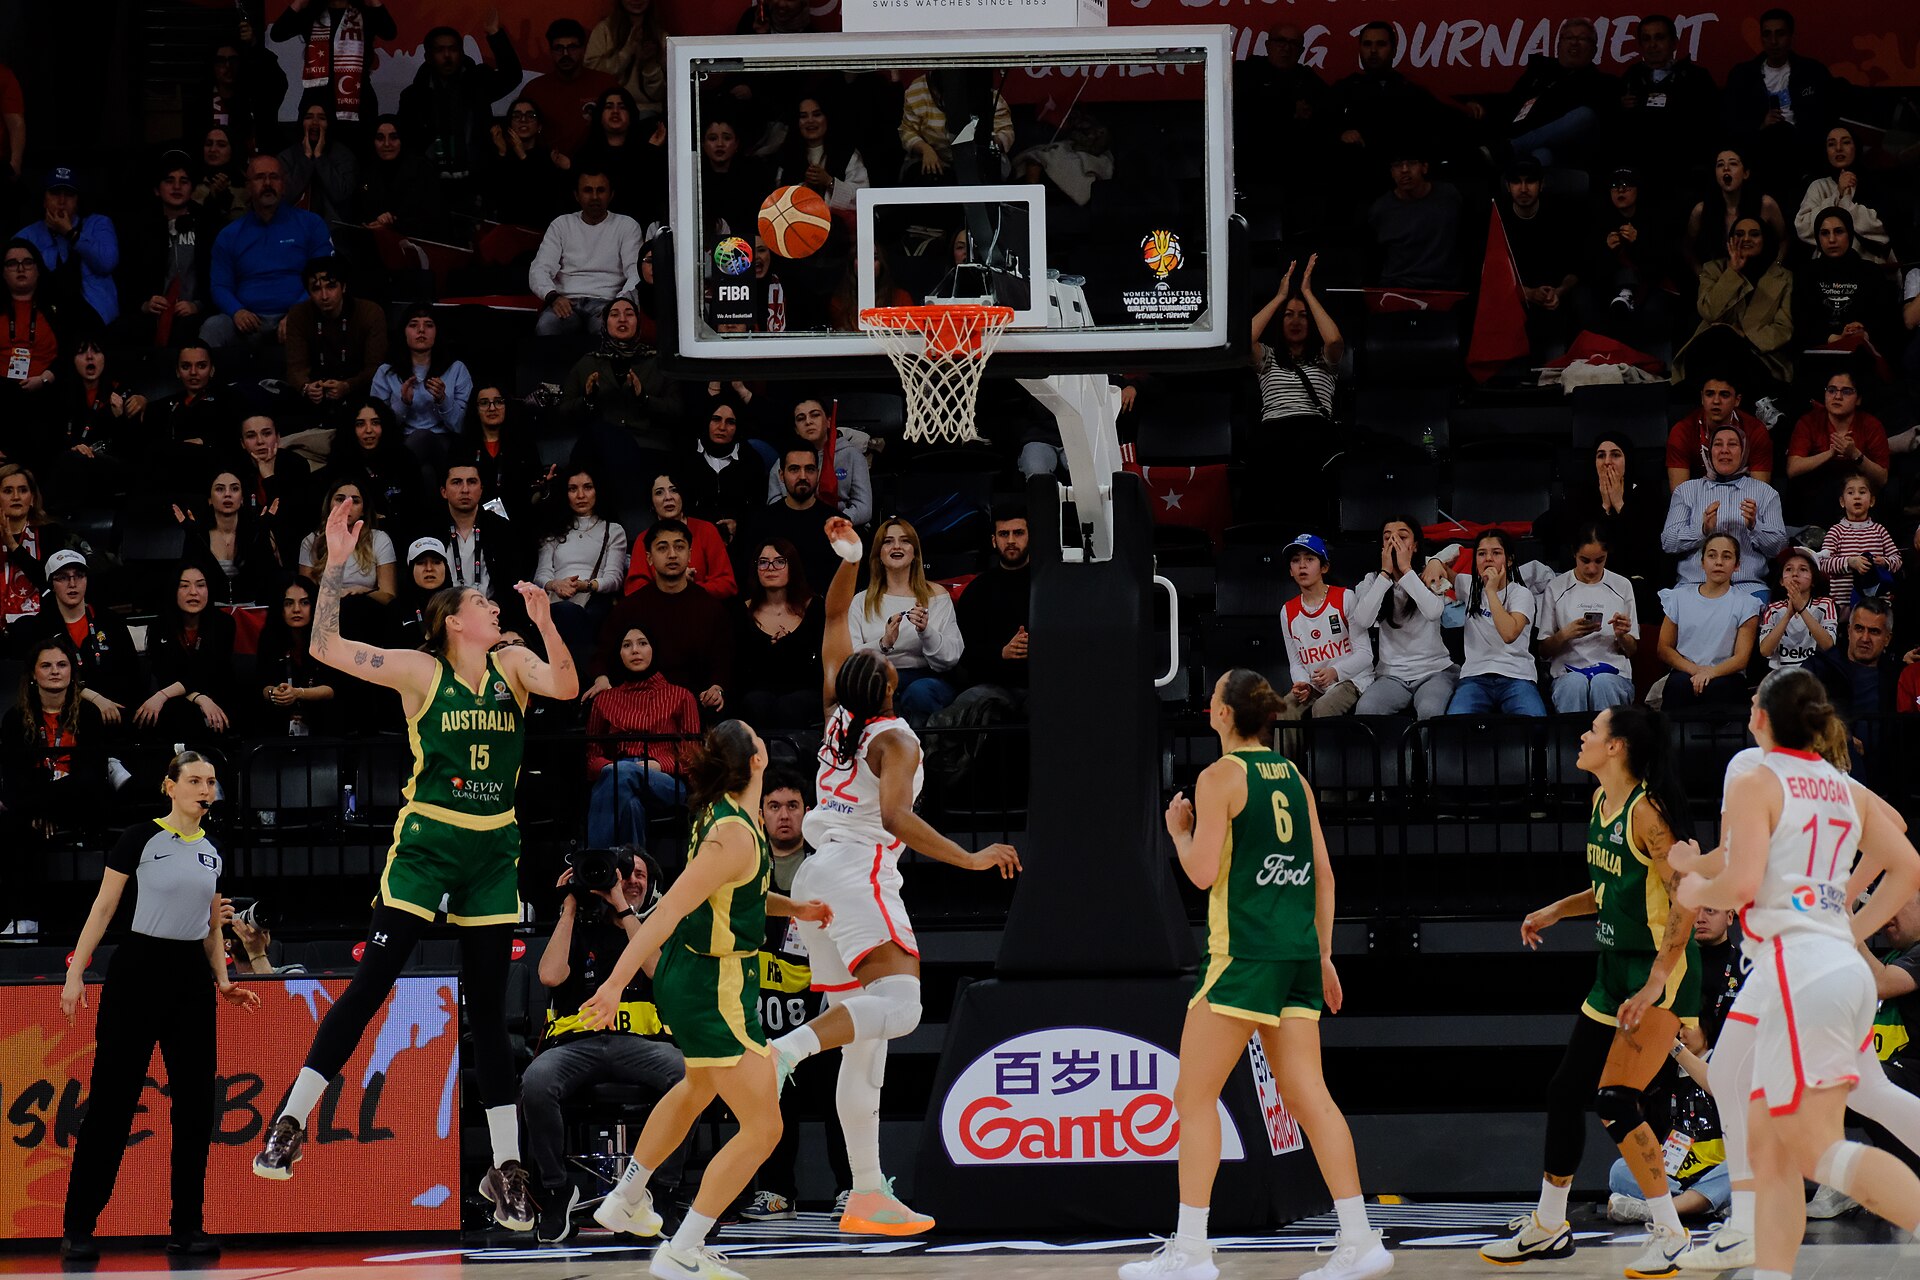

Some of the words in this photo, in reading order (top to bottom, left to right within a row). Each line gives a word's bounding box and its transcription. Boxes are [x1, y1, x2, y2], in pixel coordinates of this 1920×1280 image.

[872, 0, 909, 8] SWISS
[718, 285, 750, 301] FIBA
[1123, 297, 1157, 305] WORLD
[1159, 296, 1178, 305] CUP
[1179, 296, 1202, 304] 2026
[1126, 304, 1158, 312] QUALIFYING
[1298, 638, 1352, 666] ÜRKİYE
[1779, 643, 1816, 659] beko
[441, 709, 516, 733] AUSTRALIA
[469, 743, 490, 771] 15
[1254, 762, 1291, 780] TALBOT
[451, 789, 500, 802] CONSULTING
[465, 779, 504, 793] SEVEN
[1786, 775, 1850, 806] ERDOĞAN
[1271, 789, 1294, 844] 6
[1802, 813, 1852, 881] 17
[1255, 853, 1312, 887] Ford
[1586, 842, 1622, 877] STRALIA
[618, 1010, 631, 1032] B
[993, 1049, 1158, 1096] 百岁山
[958, 1093, 1181, 1160] Gante
